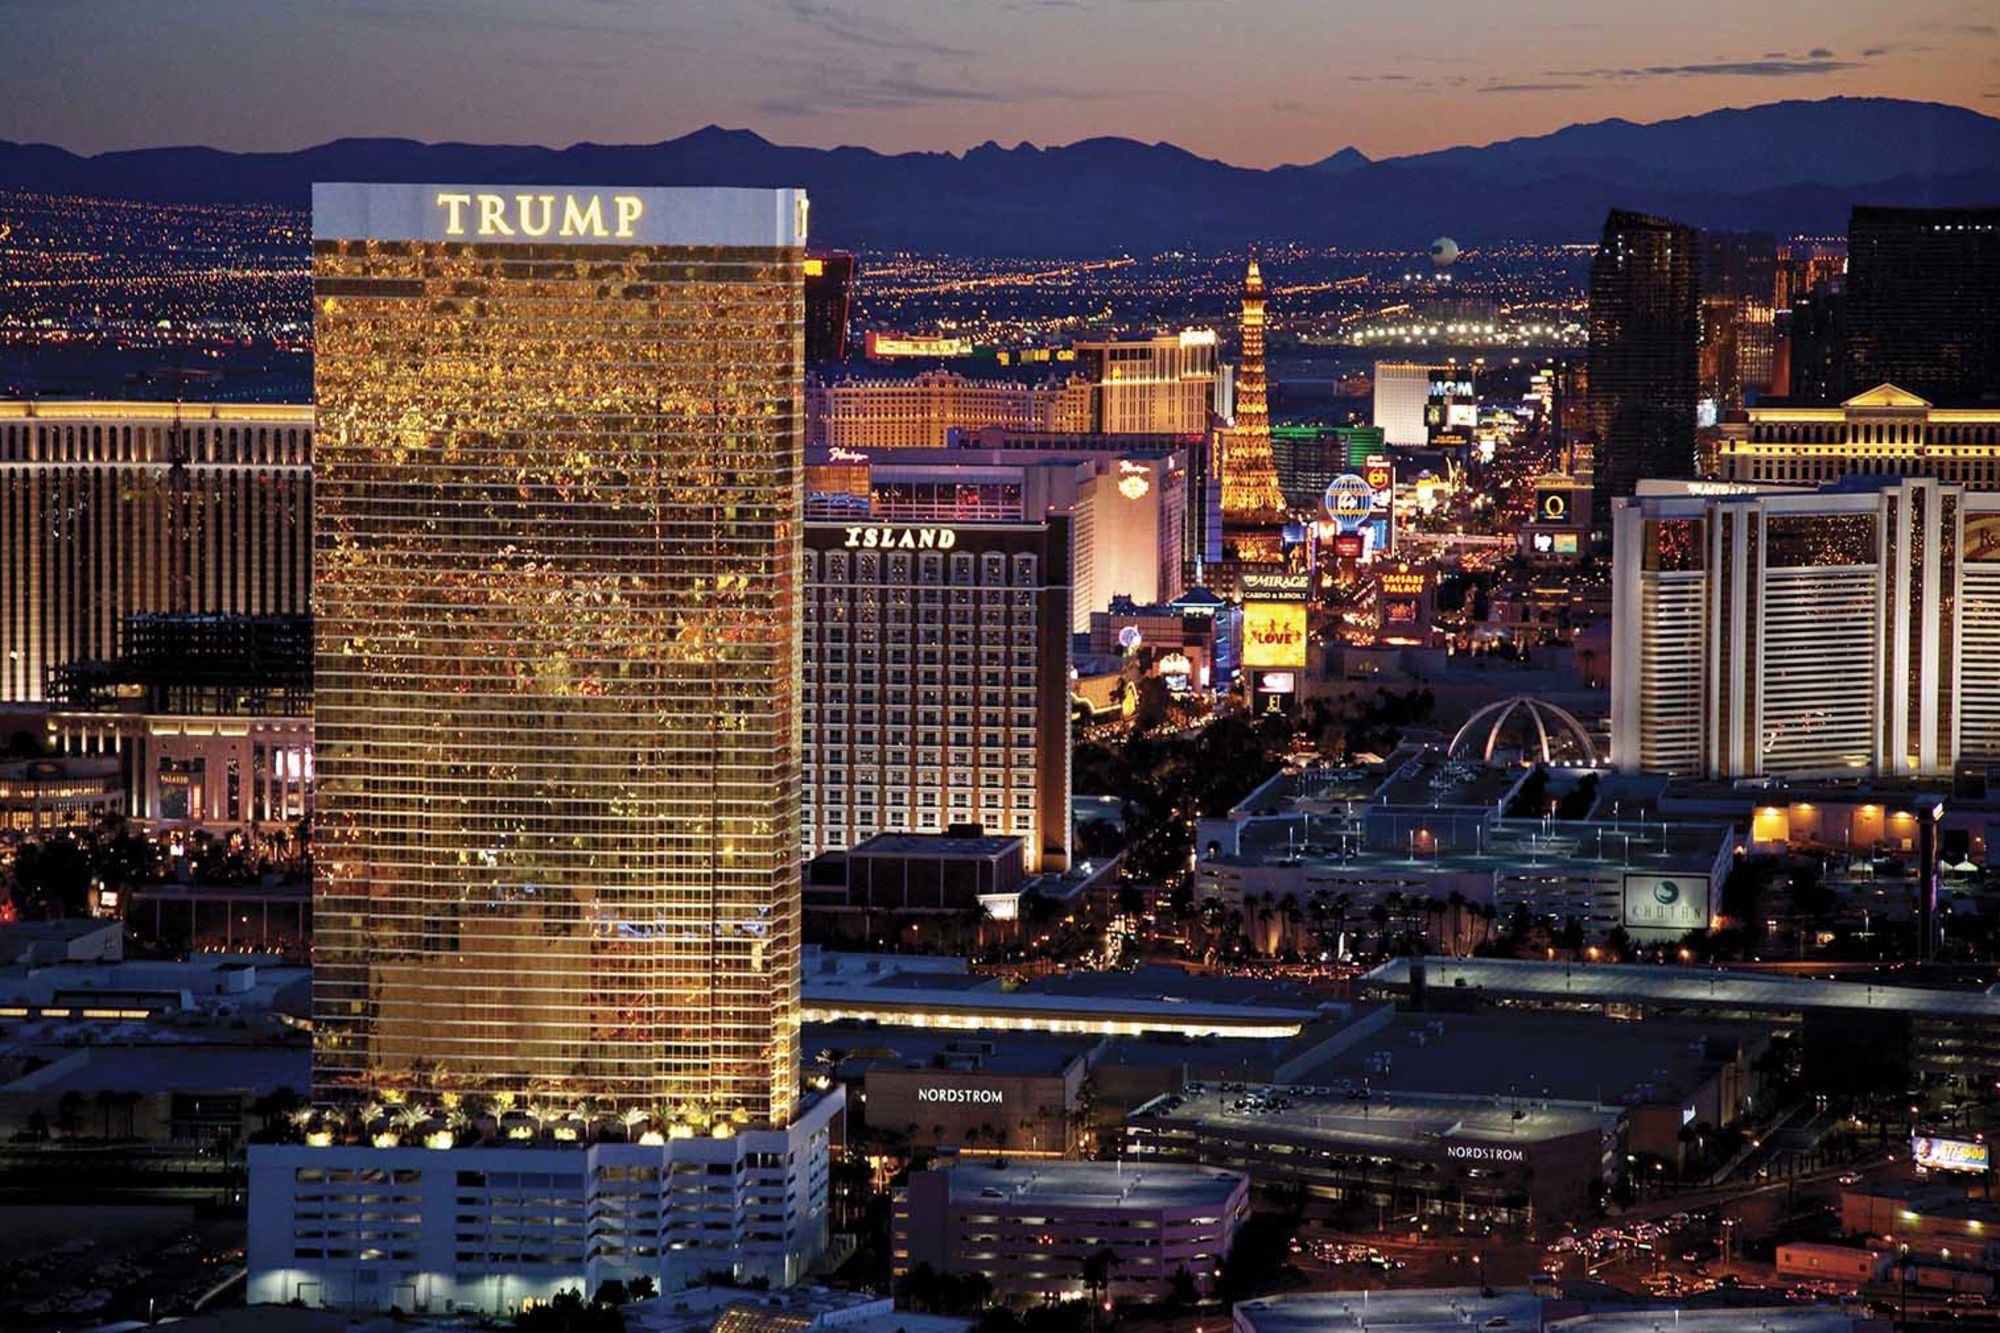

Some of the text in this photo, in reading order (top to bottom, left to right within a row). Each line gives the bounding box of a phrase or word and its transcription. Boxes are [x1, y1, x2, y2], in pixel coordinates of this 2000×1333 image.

[437, 193, 643, 237] TRUMP
[1428, 381, 1473, 396] MGM
[844, 526, 956, 549] ISLAND
[1251, 574, 1309, 589] MIRAGE
[1382, 574, 1424, 583] CAESARS
[1384, 583, 1422, 593] PALACE
[1258, 632, 1292, 645] LOVE
[1632, 905, 1702, 920] KHOTAN
[918, 1088, 1003, 1103] NORDSTROM
[1447, 1146, 1523, 1162] NORDSTROM
